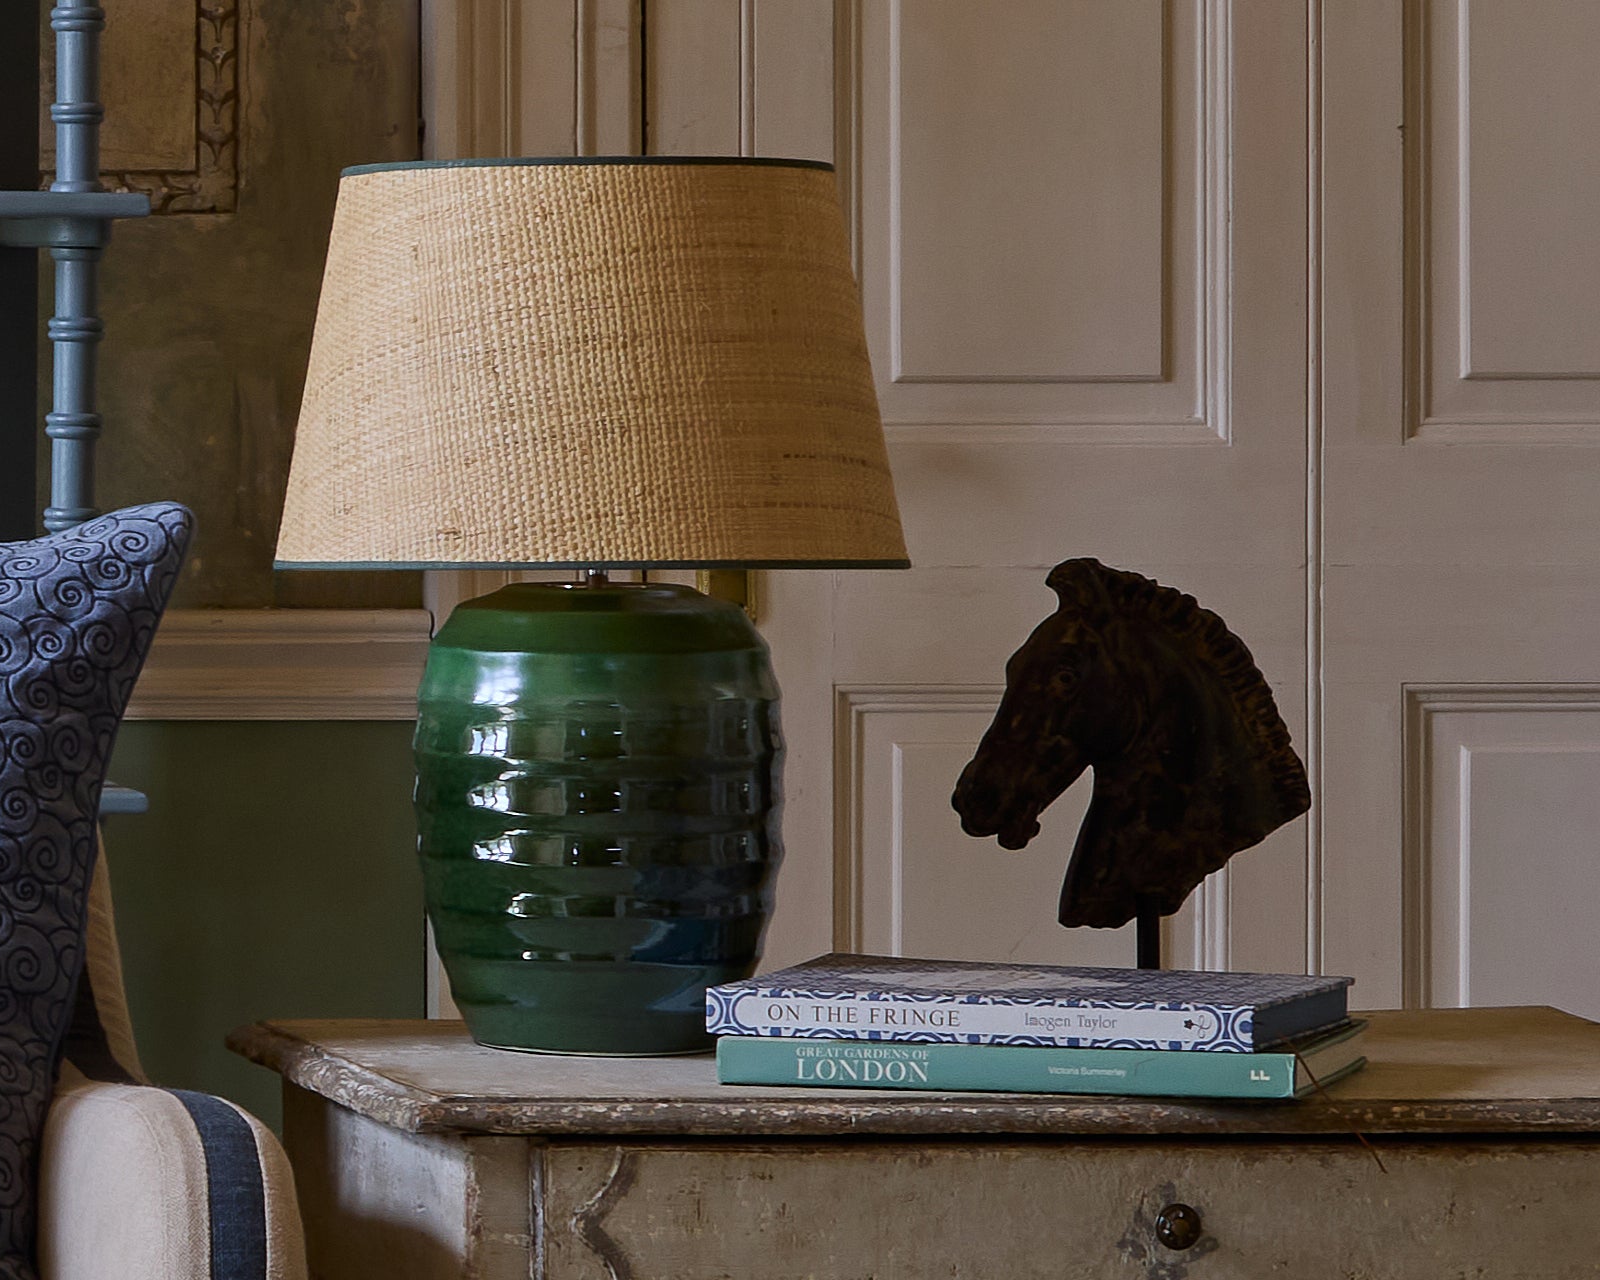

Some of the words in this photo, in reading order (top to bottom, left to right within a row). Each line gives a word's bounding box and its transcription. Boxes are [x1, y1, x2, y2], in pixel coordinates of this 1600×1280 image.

[767, 1003, 800, 1021] ON
[811, 1005, 858, 1024] THE
[870, 1007, 961, 1027] FRINGE
[1024, 1012, 1071, 1032] Imogen
[1077, 1014, 1118, 1032] Taylor
[795, 1046, 840, 1058] GREAT
[844, 1047, 909, 1060] GARDENS
[912, 1049, 929, 1061] OF
[797, 1058, 930, 1083] LONDON
